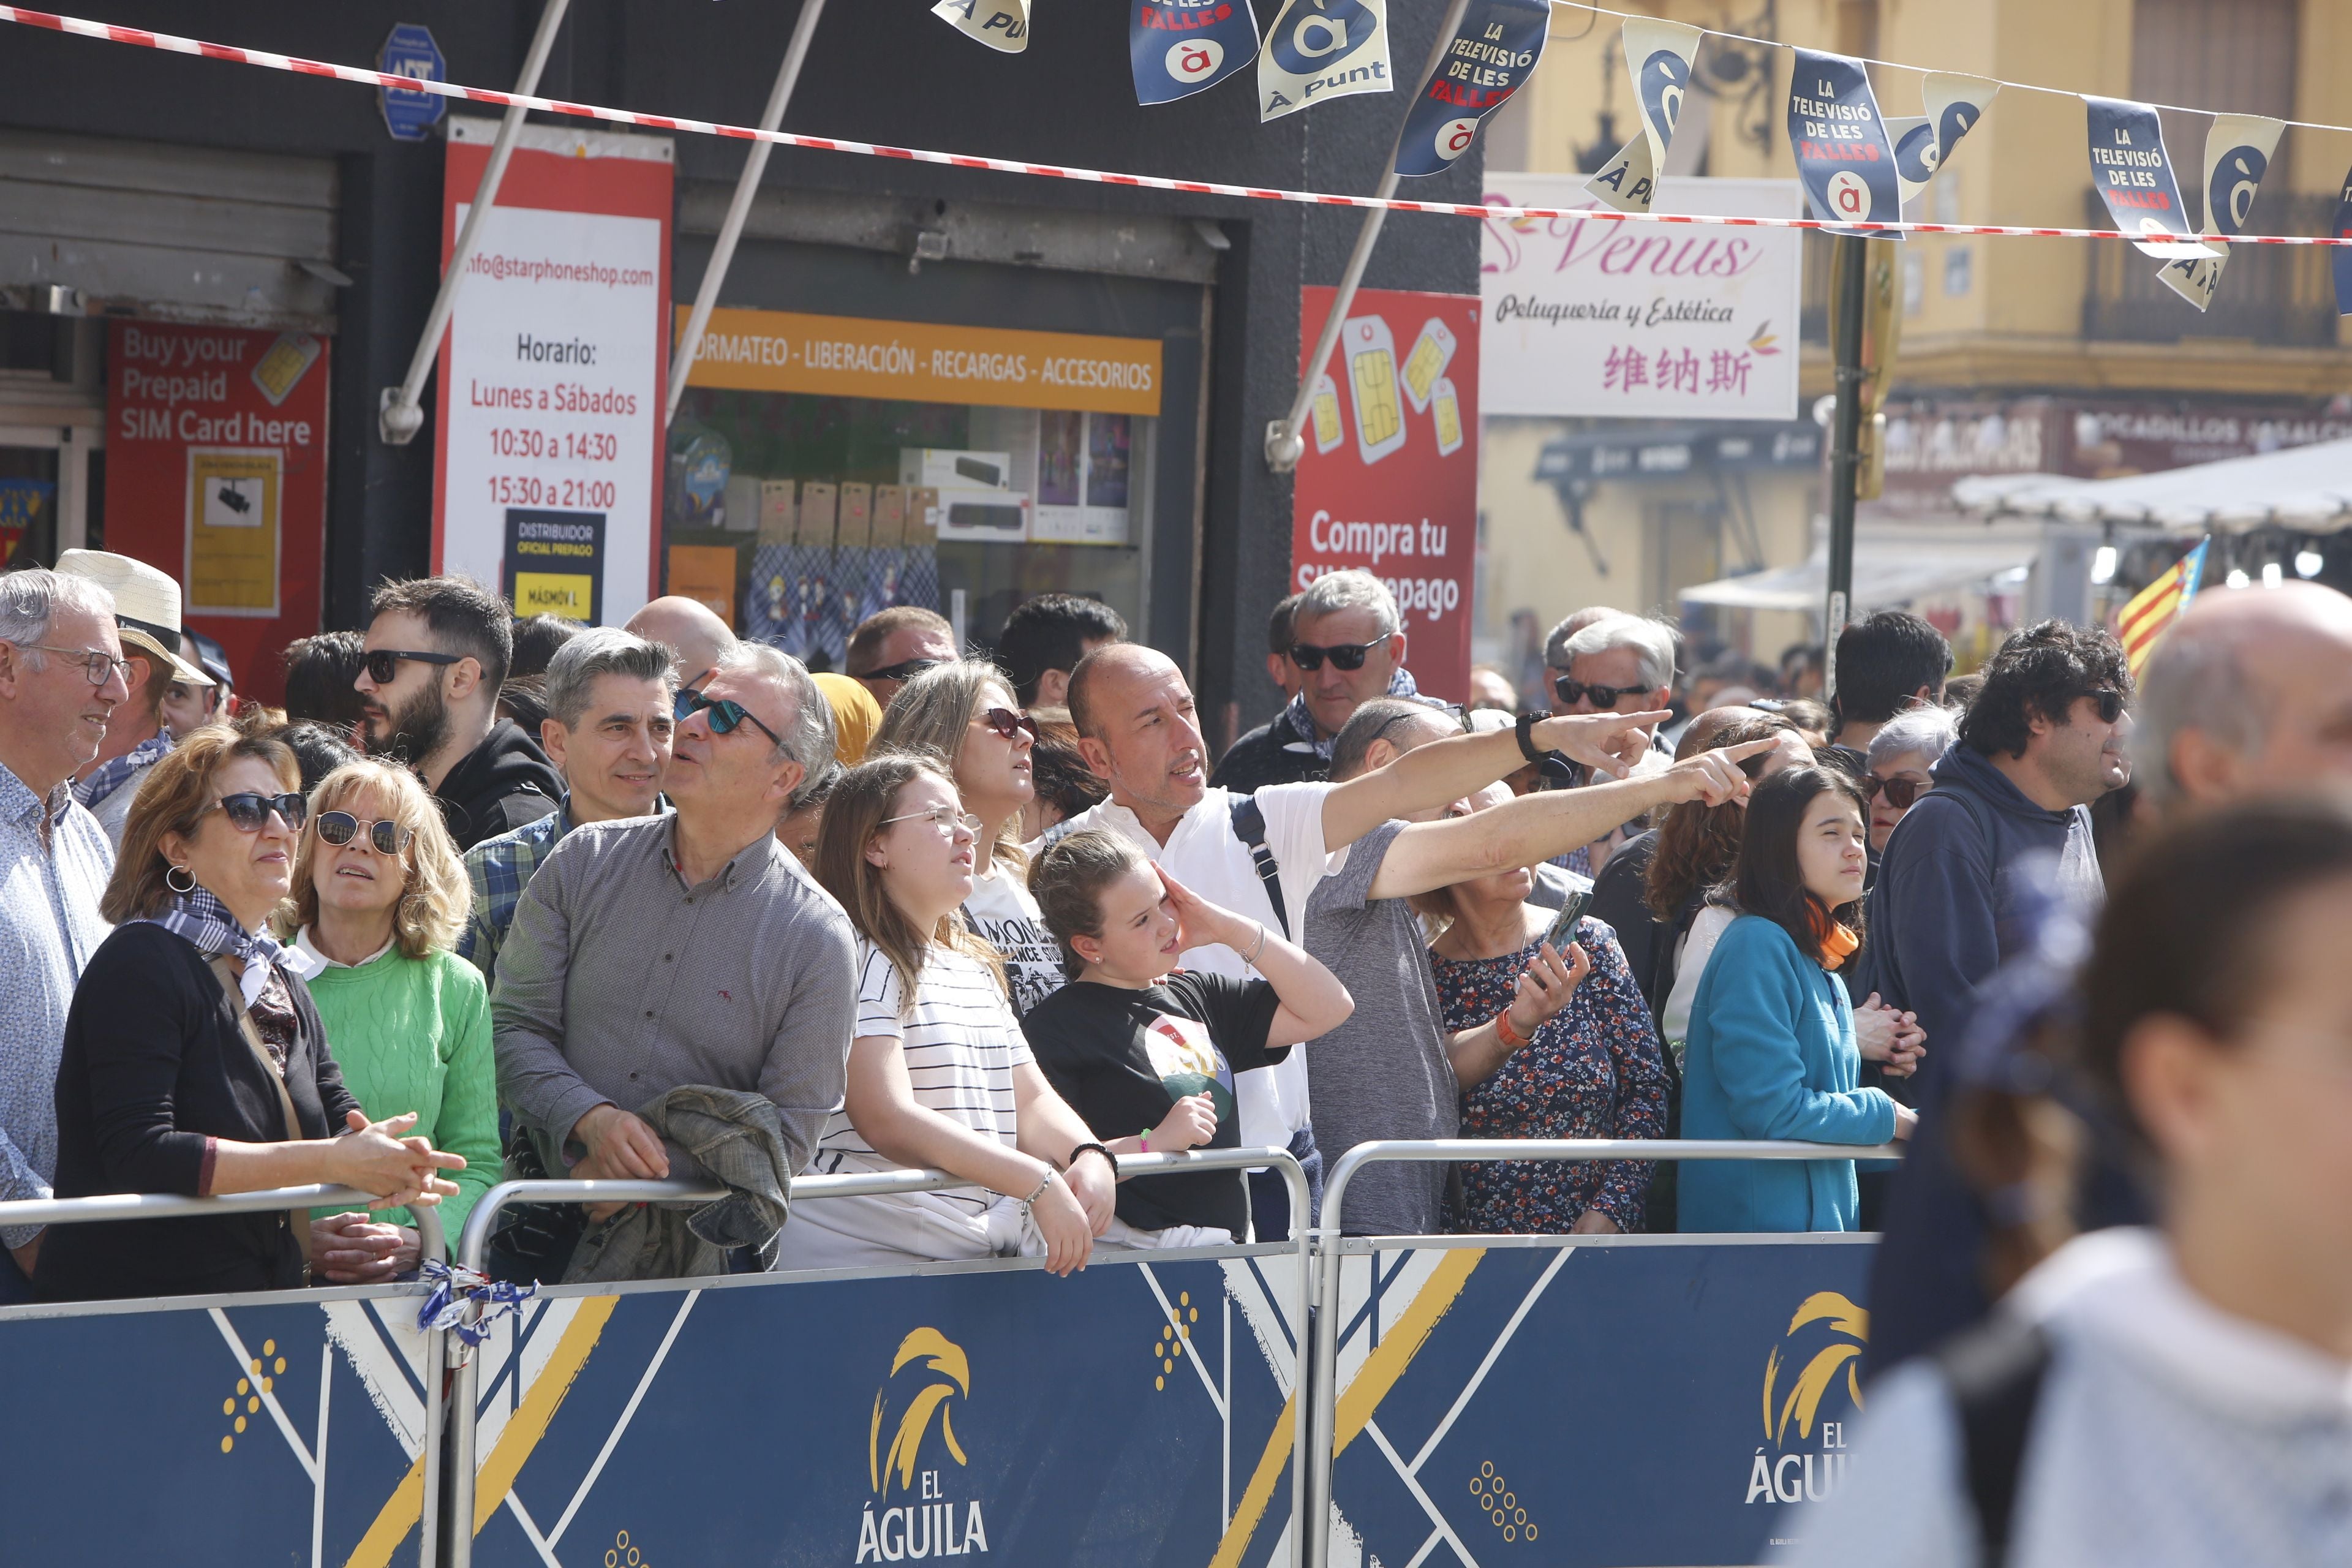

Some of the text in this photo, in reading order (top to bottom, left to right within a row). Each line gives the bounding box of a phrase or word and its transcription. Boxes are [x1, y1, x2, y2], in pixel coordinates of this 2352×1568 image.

[1140, 3, 1233, 31] FALLES
[1483, 22, 1504, 41] LA
[1450, 38, 1533, 68] TELEVISIÓ
[1265, 61, 1386, 113] À Punt
[1447, 60, 1510, 87] DE LES
[1818, 78, 1835, 99] LA
[1793, 95, 1872, 122] TELEVISIÓ
[1805, 120, 1864, 140] DE LES
[2115, 128, 2132, 146] LA
[1800, 140, 1880, 162] FALLES
[2092, 148, 2163, 168] TELEVISIÓ
[1596, 161, 1629, 192] À
[2108, 170, 2157, 187] DE LES
[2106, 189, 2171, 211] FALLES
[1548, 200, 1764, 277] Venus
[466, 252, 654, 288] nfo@starphoneshop.com
[1496, 294, 1735, 328] Peluquería y Estética
[124, 327, 247, 367] Buy your
[516, 333, 597, 366] Horario:
[692, 333, 788, 366] ORMATEO
[805, 339, 916, 375] LIBERACIÓN
[931, 349, 1027, 382] RECARGAS
[1041, 356, 1153, 391] ACCESORIOS
[1602, 344, 1753, 397] 维纳斯
[123, 368, 227, 407] Prepaid
[471, 379, 636, 416] Lunes a Sábados
[121, 407, 311, 445] SIM Card here
[490, 428, 617, 461] 10:30 a 14:30
[488, 476, 616, 508] 15:30 a 21:00
[519, 522, 594, 541] DISTRIBUIDOR
[1310, 510, 1447, 564] Compra tu
[518, 541, 594, 557] OFICIAL PREPAGO
[1361, 566, 1459, 621] epago
[1823, 1422, 1847, 1449] EL
[922, 1470, 943, 1500] EL
[1744, 1447, 1856, 1504] ÁGUI
[854, 1500, 989, 1565] ÁGUILA
